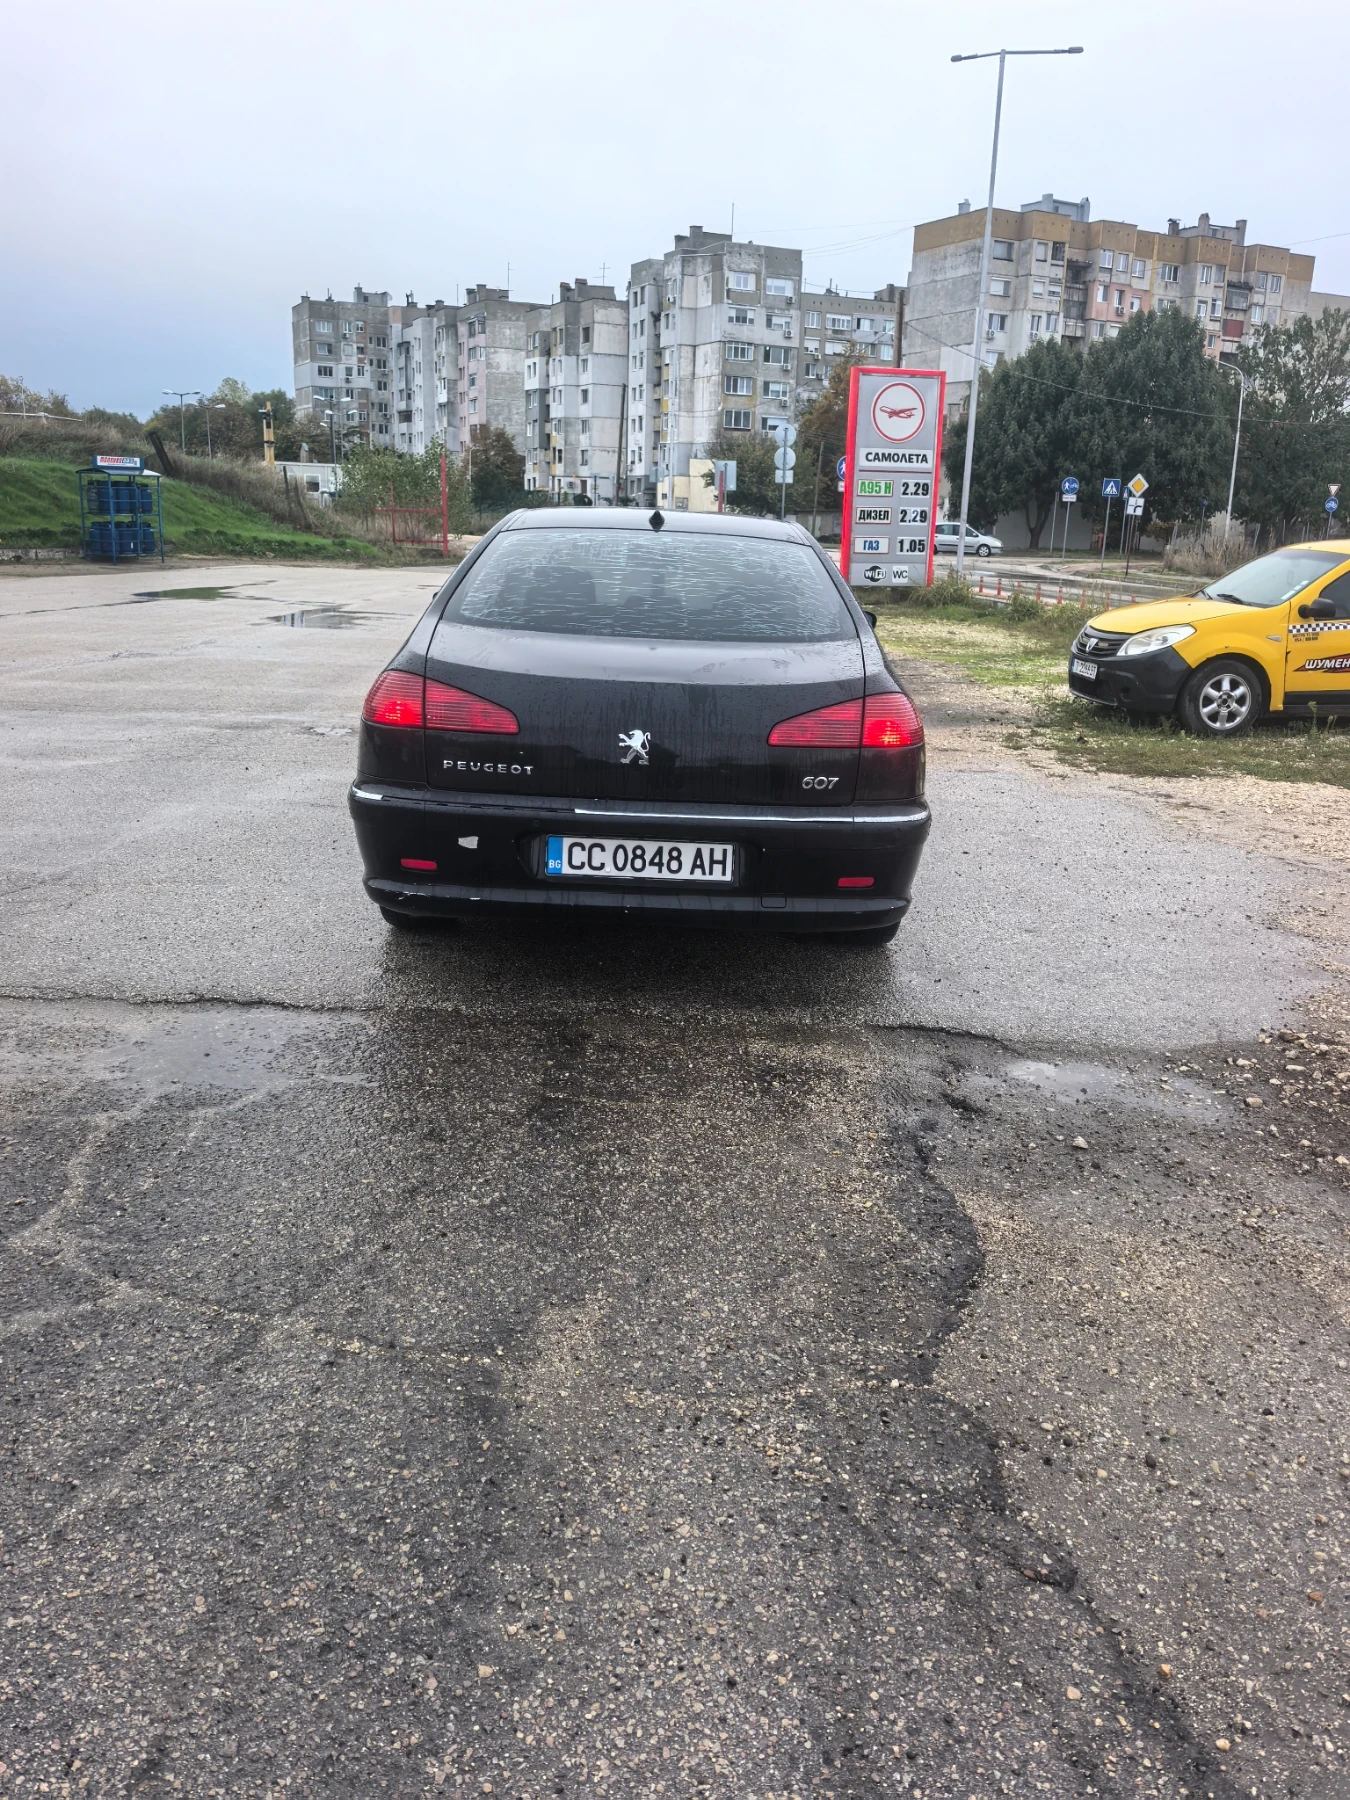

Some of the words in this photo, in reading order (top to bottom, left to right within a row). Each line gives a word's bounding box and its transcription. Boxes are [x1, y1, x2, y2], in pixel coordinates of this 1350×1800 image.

[865, 452, 929, 464] САМОЛЕТА
[860, 481, 881, 494] A95
[901, 482, 929, 496] 2.29
[858, 509, 889, 521] ДИЗЕЛ
[900, 509, 928, 523] 2.29
[863, 540, 880, 552] ГАЗ
[898, 539, 925, 552] 1.05
[893, 570, 908, 579] WC
[1305, 658, 1350, 669] ШУМЕН
[443, 759, 534, 775] PEUGEOT
[801, 776, 840, 790] 607
[548, 859, 561, 869] BG
[567, 841, 606, 871] CC
[612, 843, 683, 875] 0848
[689, 846, 728, 877] AH
